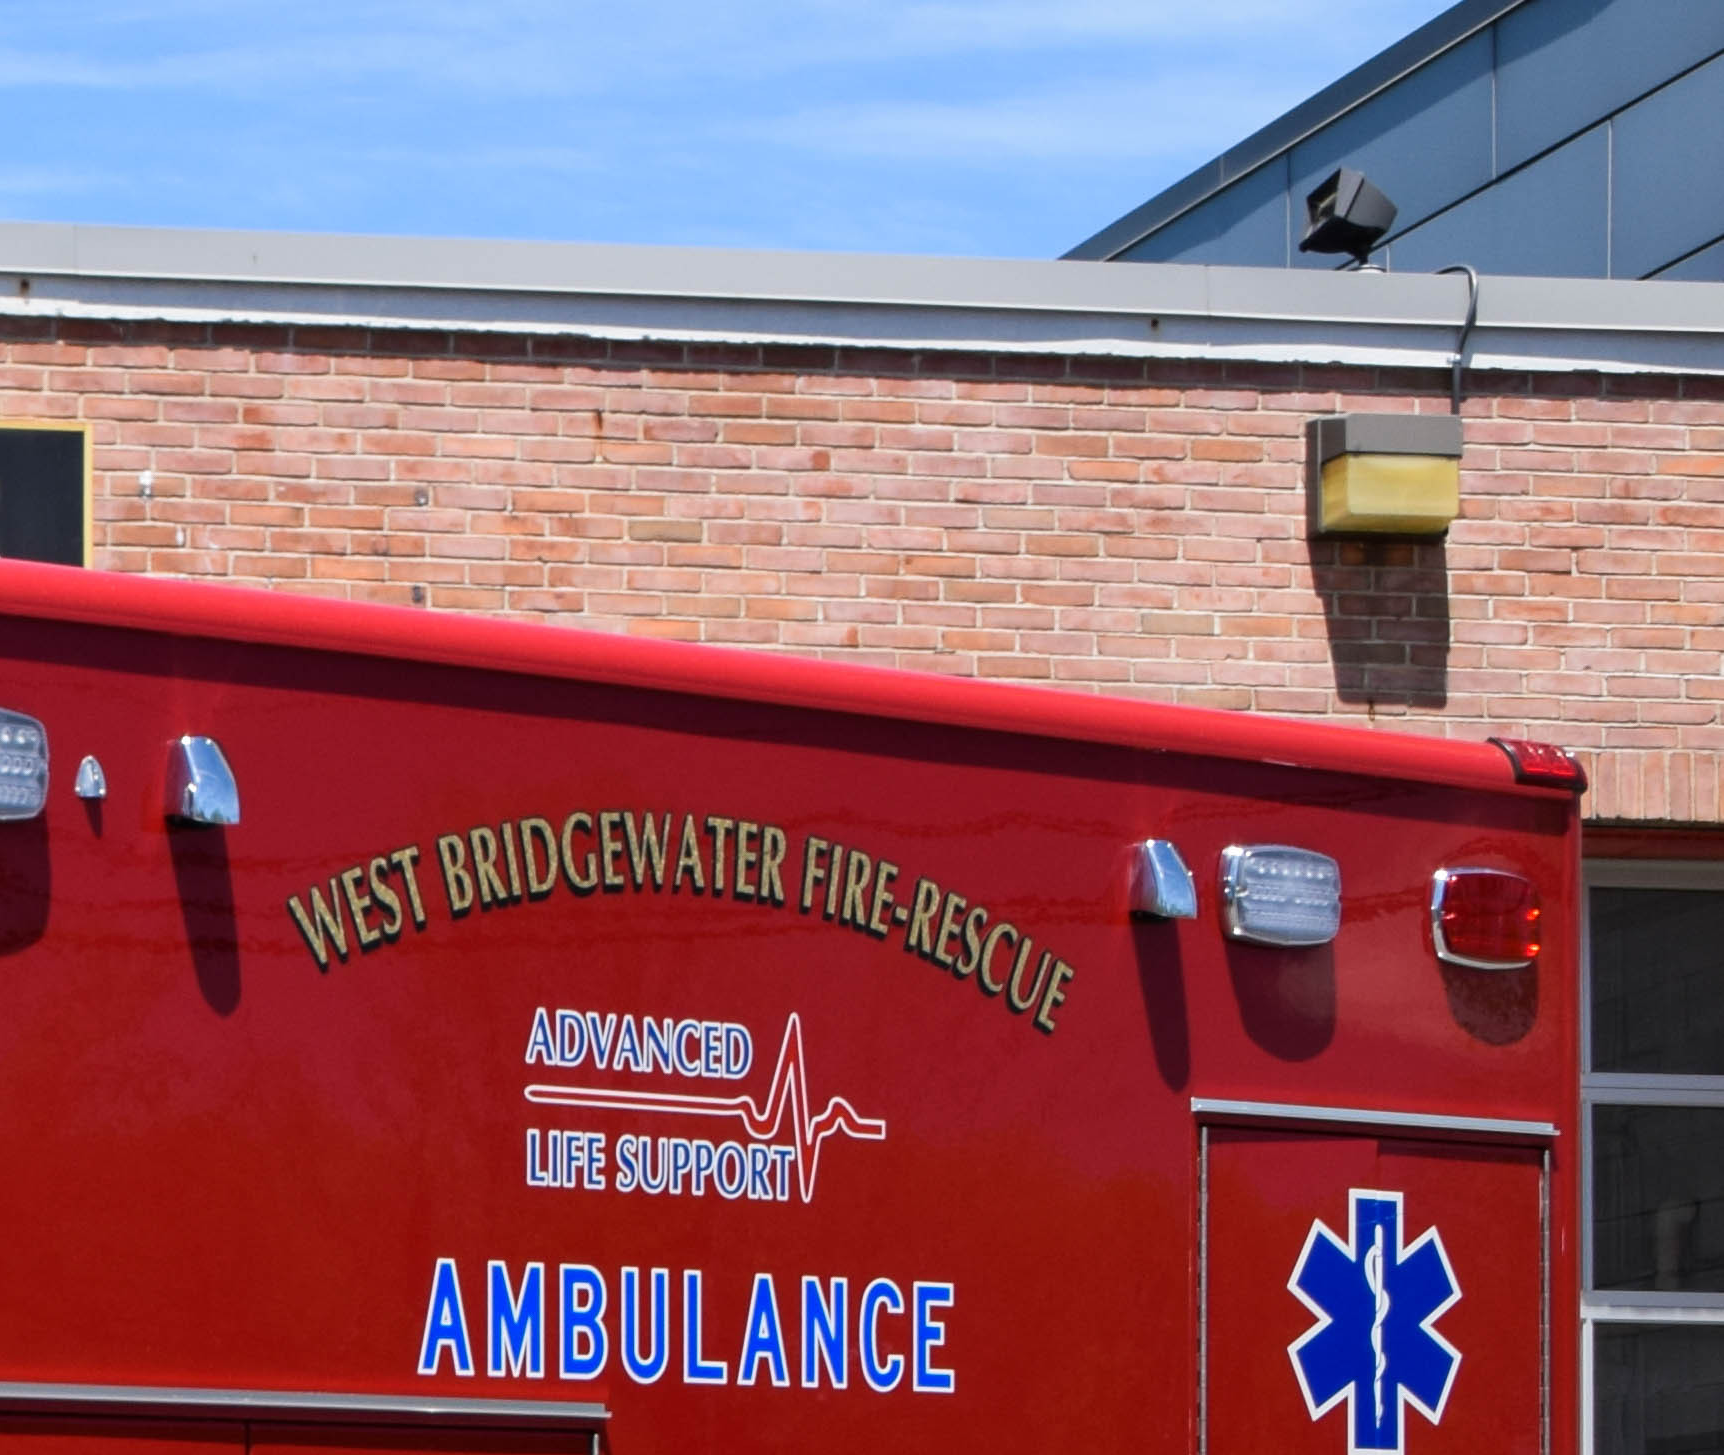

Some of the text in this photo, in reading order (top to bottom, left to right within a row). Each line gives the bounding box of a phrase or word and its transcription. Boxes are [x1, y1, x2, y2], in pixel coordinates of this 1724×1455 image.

[288, 811, 1074, 1034] WEST BRIDGEWATER FIRE-RESCUE
[525, 1007, 753, 1080] ADVANCED
[526, 1128, 795, 1202] LIFE SUPPORT
[417, 1257, 955, 1394] AMBULANCE
